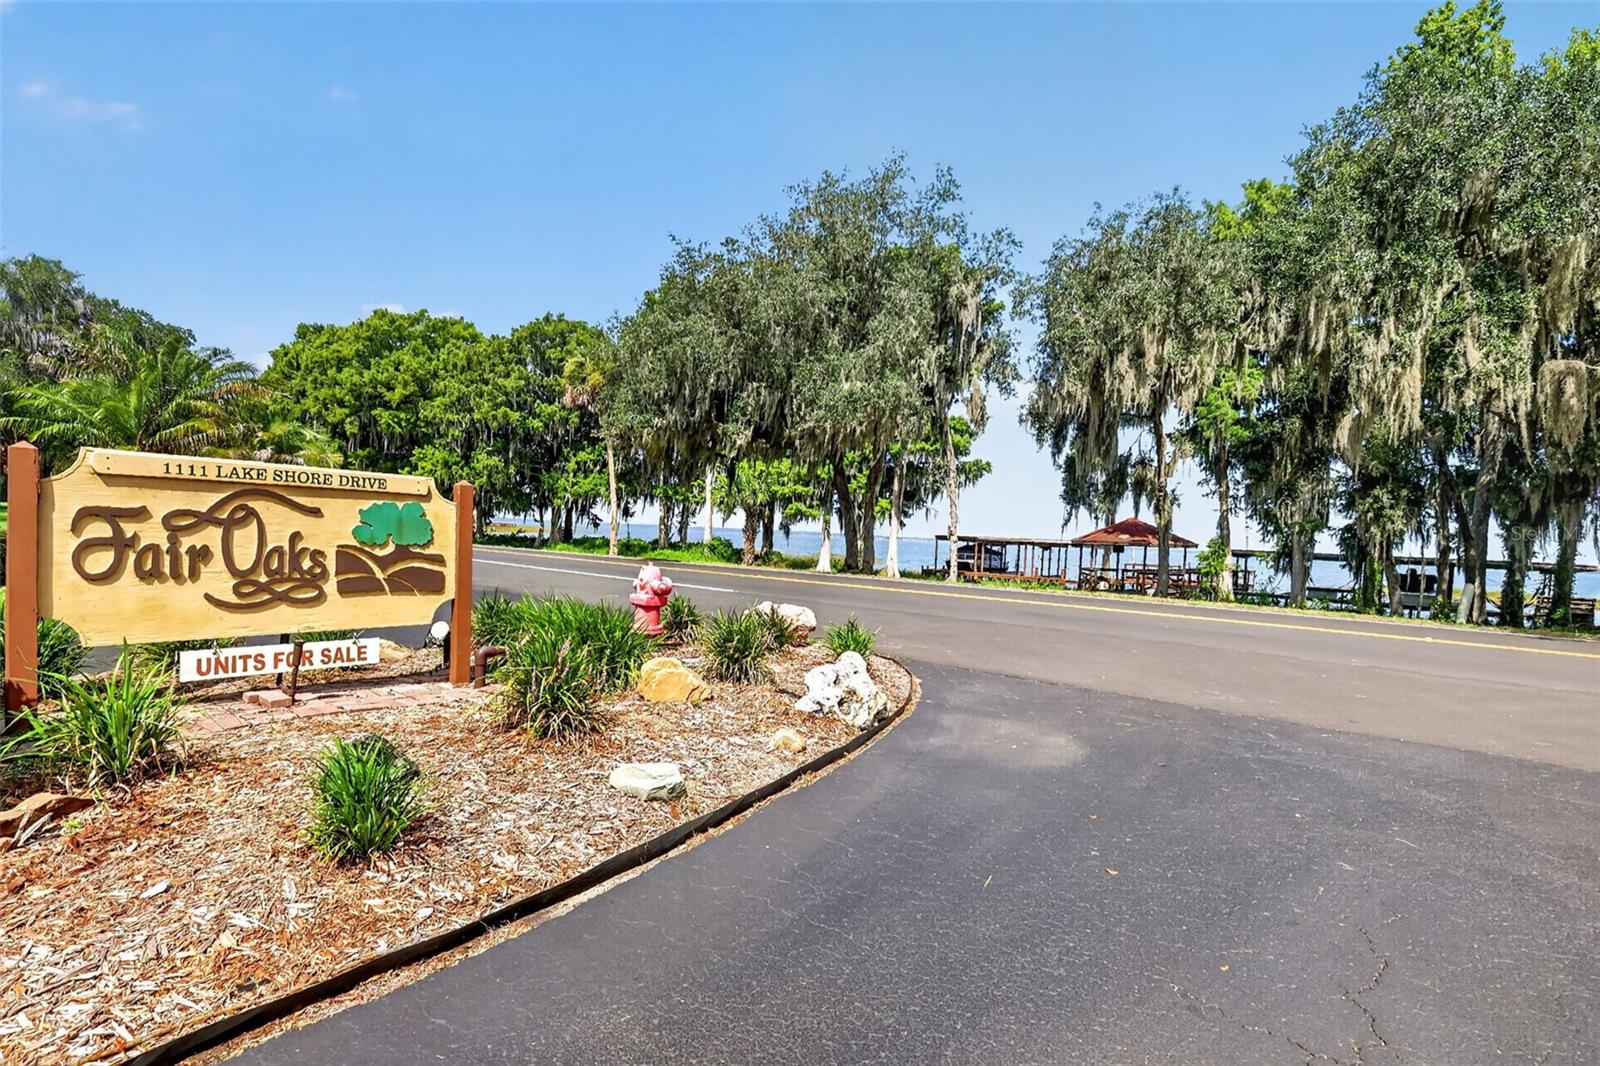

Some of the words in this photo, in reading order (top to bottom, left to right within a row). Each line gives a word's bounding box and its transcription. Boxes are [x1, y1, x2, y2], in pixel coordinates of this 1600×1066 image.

[163, 462, 208, 477] 1111
[215, 465, 267, 481] LAKE
[273, 469, 333, 485] SHORE
[339, 475, 387, 490] DRIVE
[71, 505, 208, 581] Fair
[161, 487, 327, 579] Oaks
[196, 653, 266, 676] UNITS
[273, 649, 314, 670] FOR
[320, 645, 368, 664] SALE
